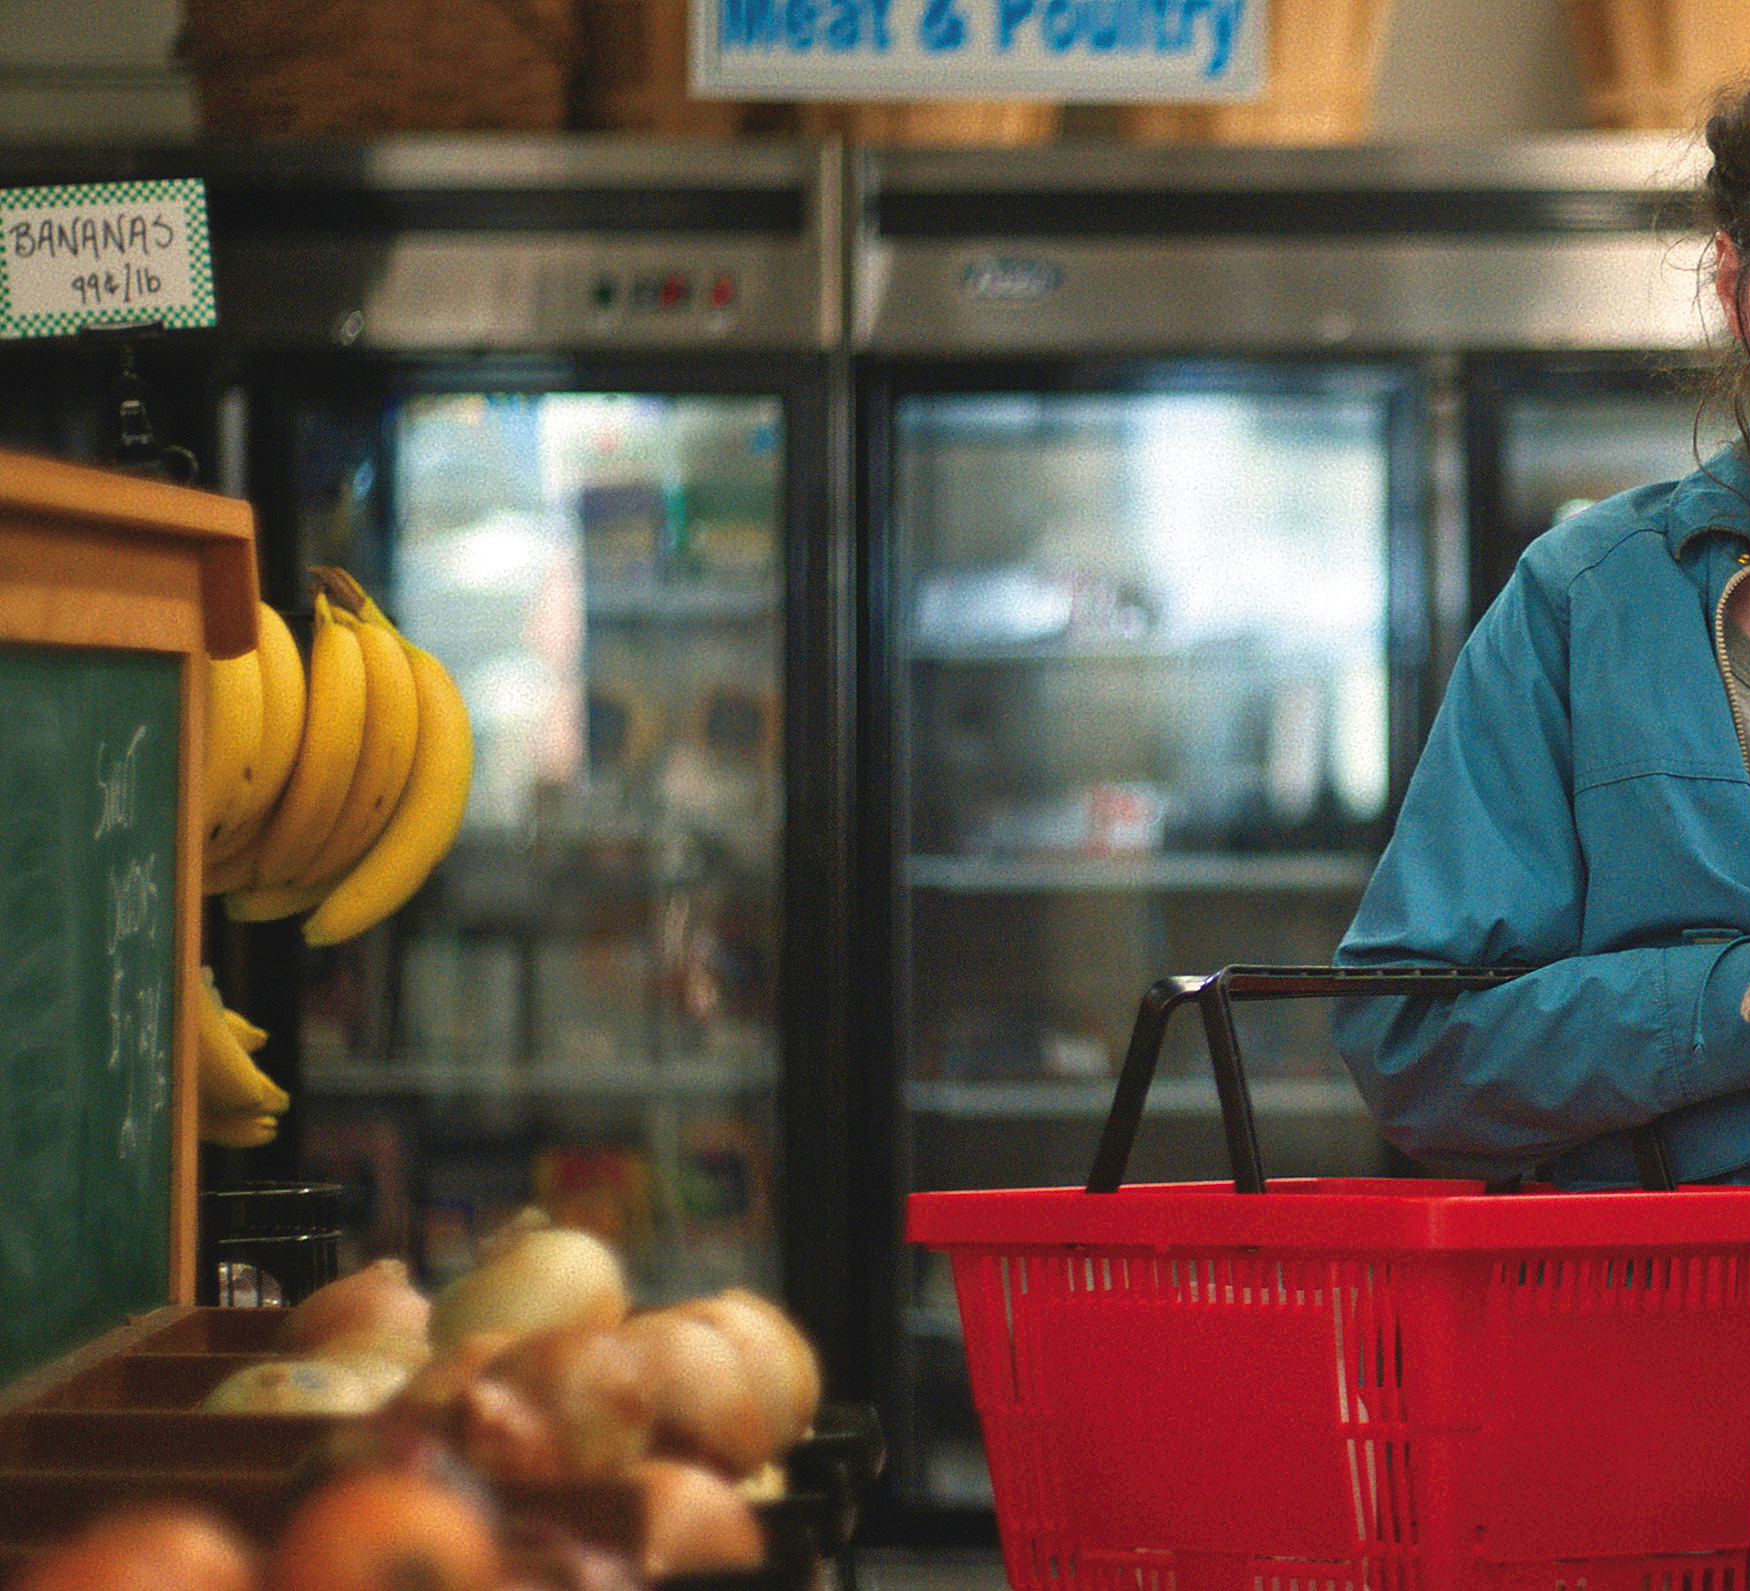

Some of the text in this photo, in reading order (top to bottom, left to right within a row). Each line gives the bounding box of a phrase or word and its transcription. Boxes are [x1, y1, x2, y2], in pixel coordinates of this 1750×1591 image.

[718, 0, 892, 52] Meat
[920, 0, 968, 54] &
[9, 213, 174, 262] BANANAS
